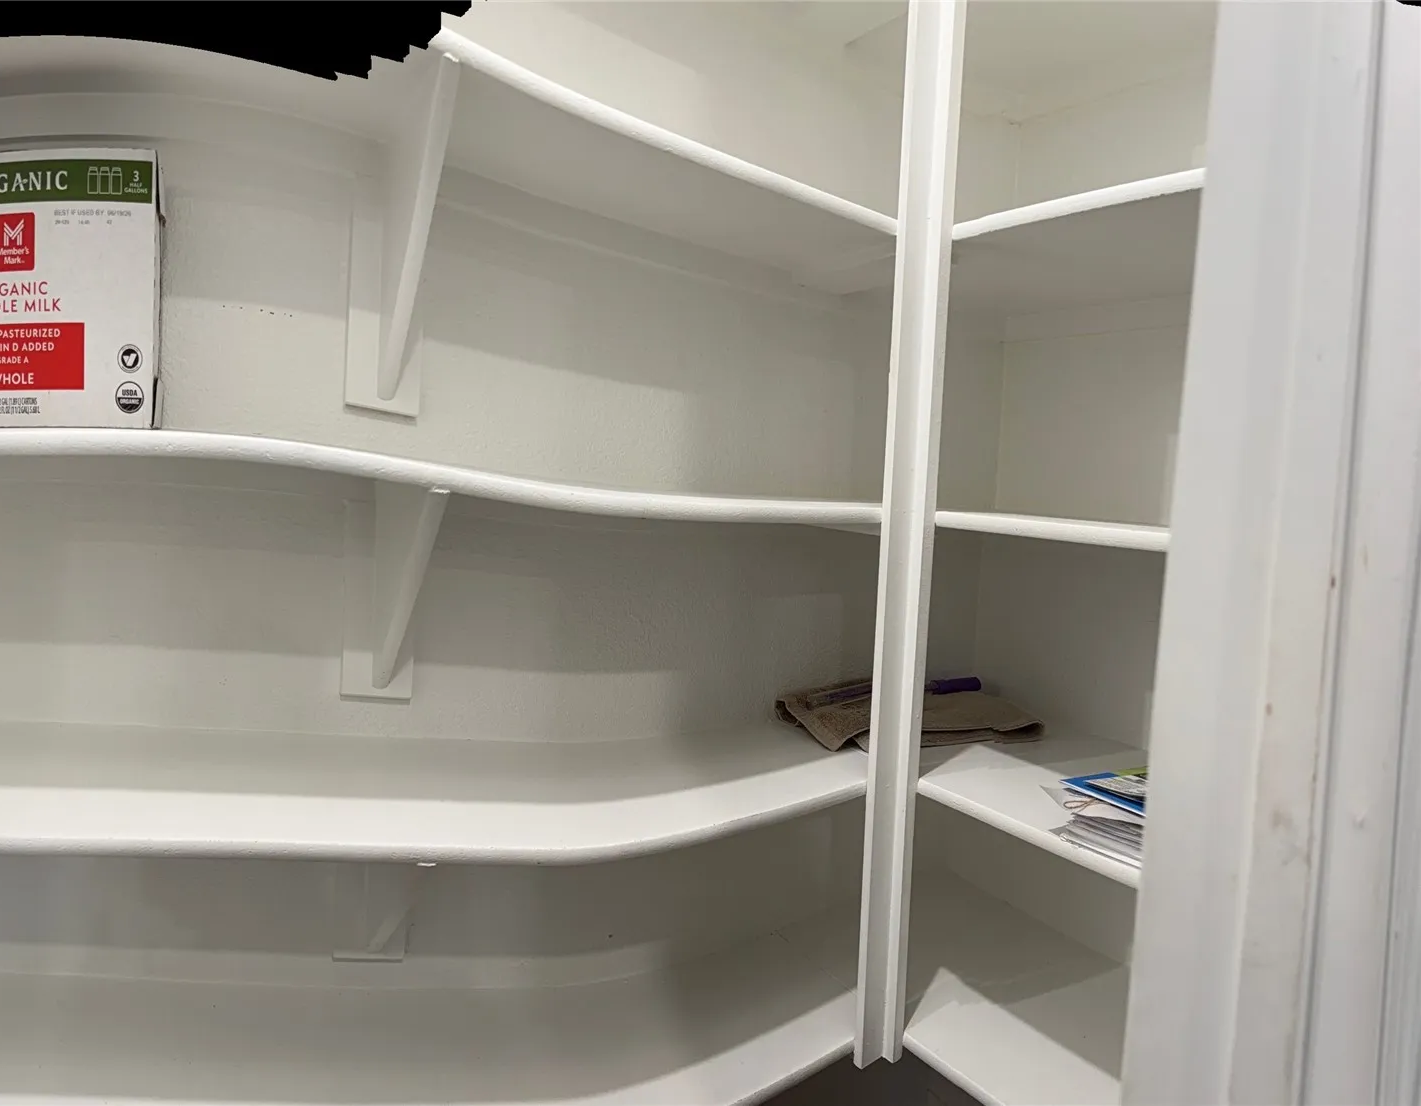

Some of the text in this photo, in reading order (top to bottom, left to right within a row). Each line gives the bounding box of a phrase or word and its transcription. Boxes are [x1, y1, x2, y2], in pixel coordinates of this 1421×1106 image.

[133, 170, 140, 182] 3
[24, 298, 62, 312] MILK
[12, 342, 19, 351] D
[21, 342, 55, 351] ADDED
[121, 389, 138, 397] USDA
